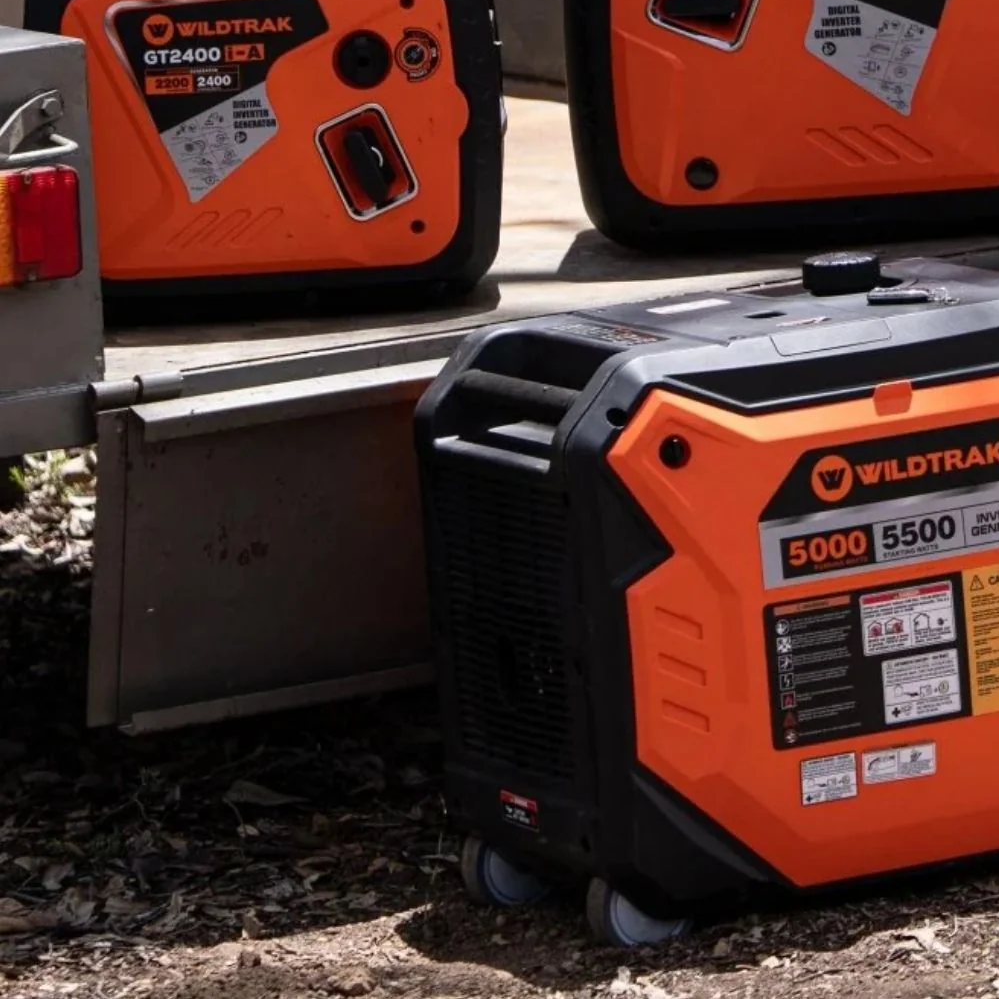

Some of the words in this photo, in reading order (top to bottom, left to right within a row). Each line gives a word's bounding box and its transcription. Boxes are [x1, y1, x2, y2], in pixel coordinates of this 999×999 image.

[828, 5, 860, 16] DIGITAL
[176, 16, 293, 37] WILDTRAK
[821, 17, 861, 27] INVERTER
[814, 27, 862, 39] GENERATOR
[144, 47, 221, 65] GT2400
[155, 78, 189, 89] 2200
[197, 74, 231, 87] 2400
[233, 100, 262, 109] DIGITAL
[233, 109, 269, 119] INVERTER
[233, 119, 277, 129] GENERATOR
[789, 529, 868, 567] 5000
[882, 514, 956, 550] 5500
[883, 546, 916, 559] STARTING
